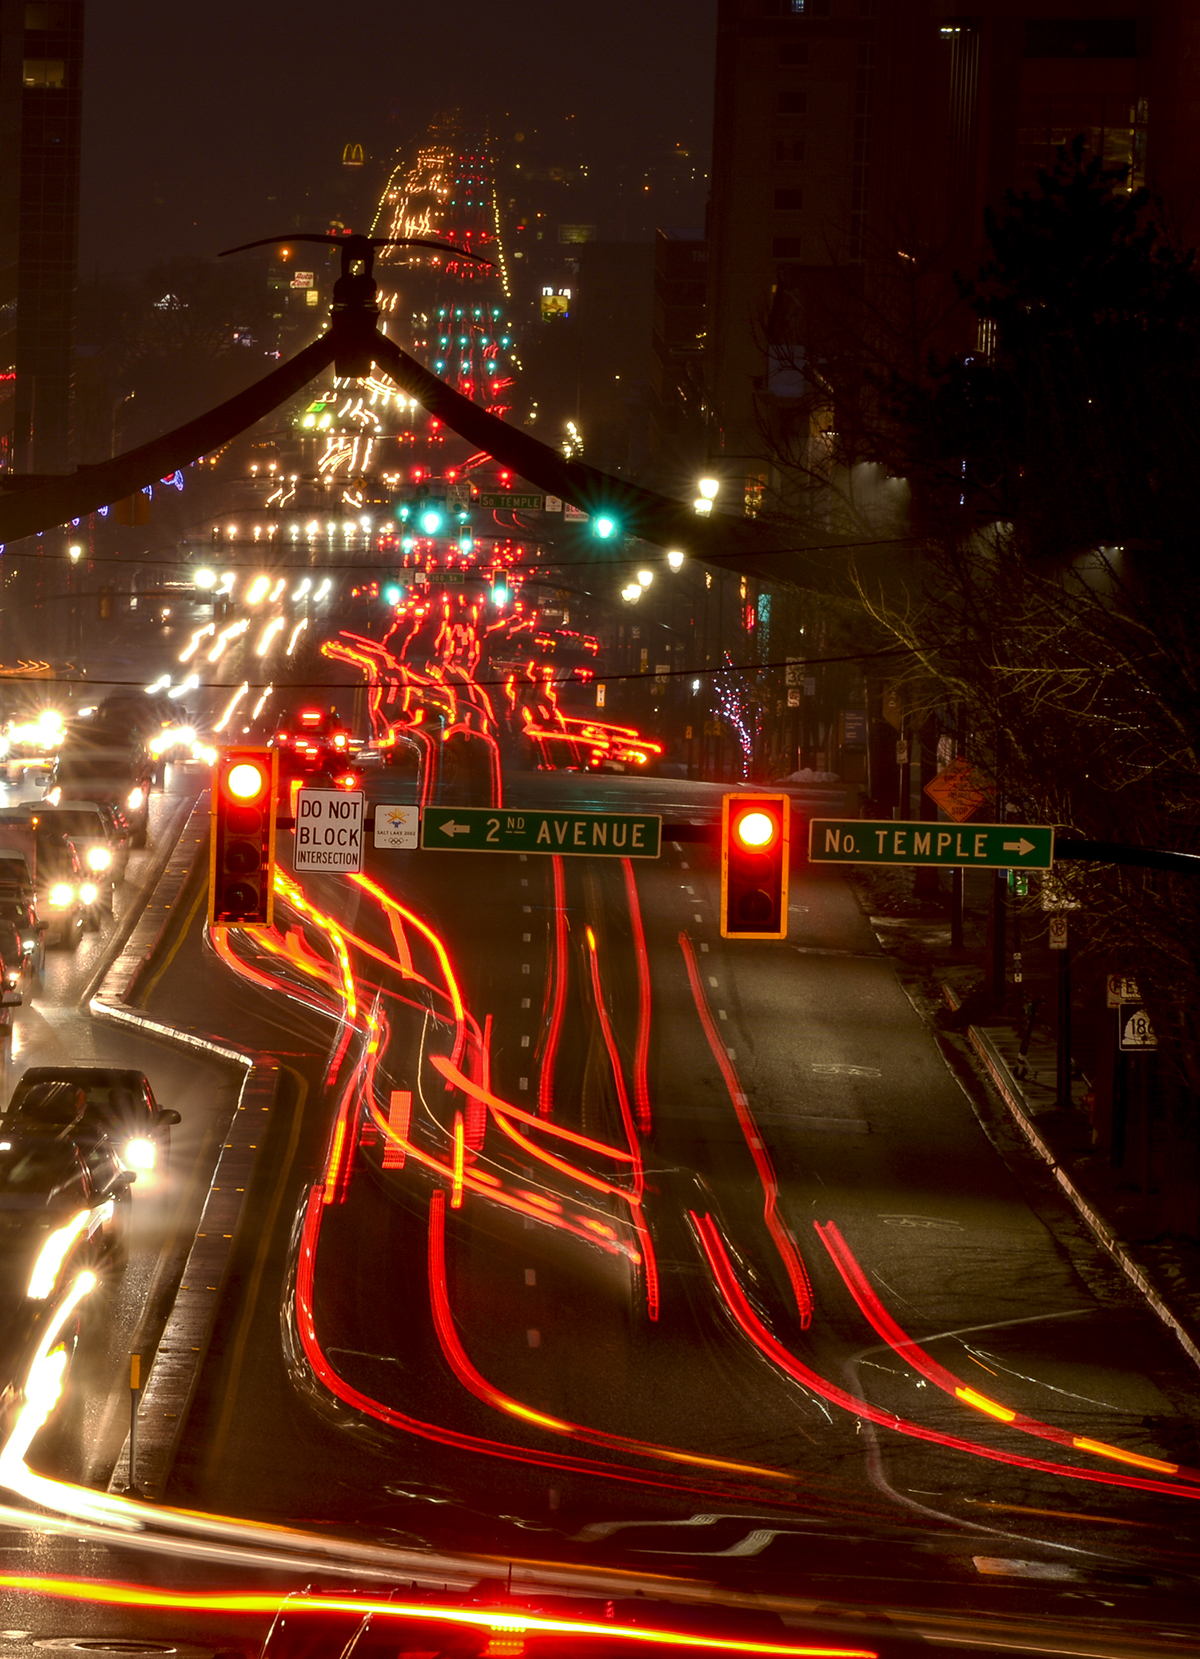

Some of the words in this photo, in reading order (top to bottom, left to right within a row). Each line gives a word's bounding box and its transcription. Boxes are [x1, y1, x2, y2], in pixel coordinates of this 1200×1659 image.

[501, 496, 539, 508] TEMPLE
[301, 800, 322, 818] DO
[329, 801, 360, 820] NOT
[951, 807, 968, 815] STOP
[300, 827, 359, 847] BLOCK
[536, 820, 645, 848] AVENUE
[825, 828, 860, 853] No.
[875, 830, 988, 858] TEMPLE
[298, 851, 359, 865] INTERSECTION
